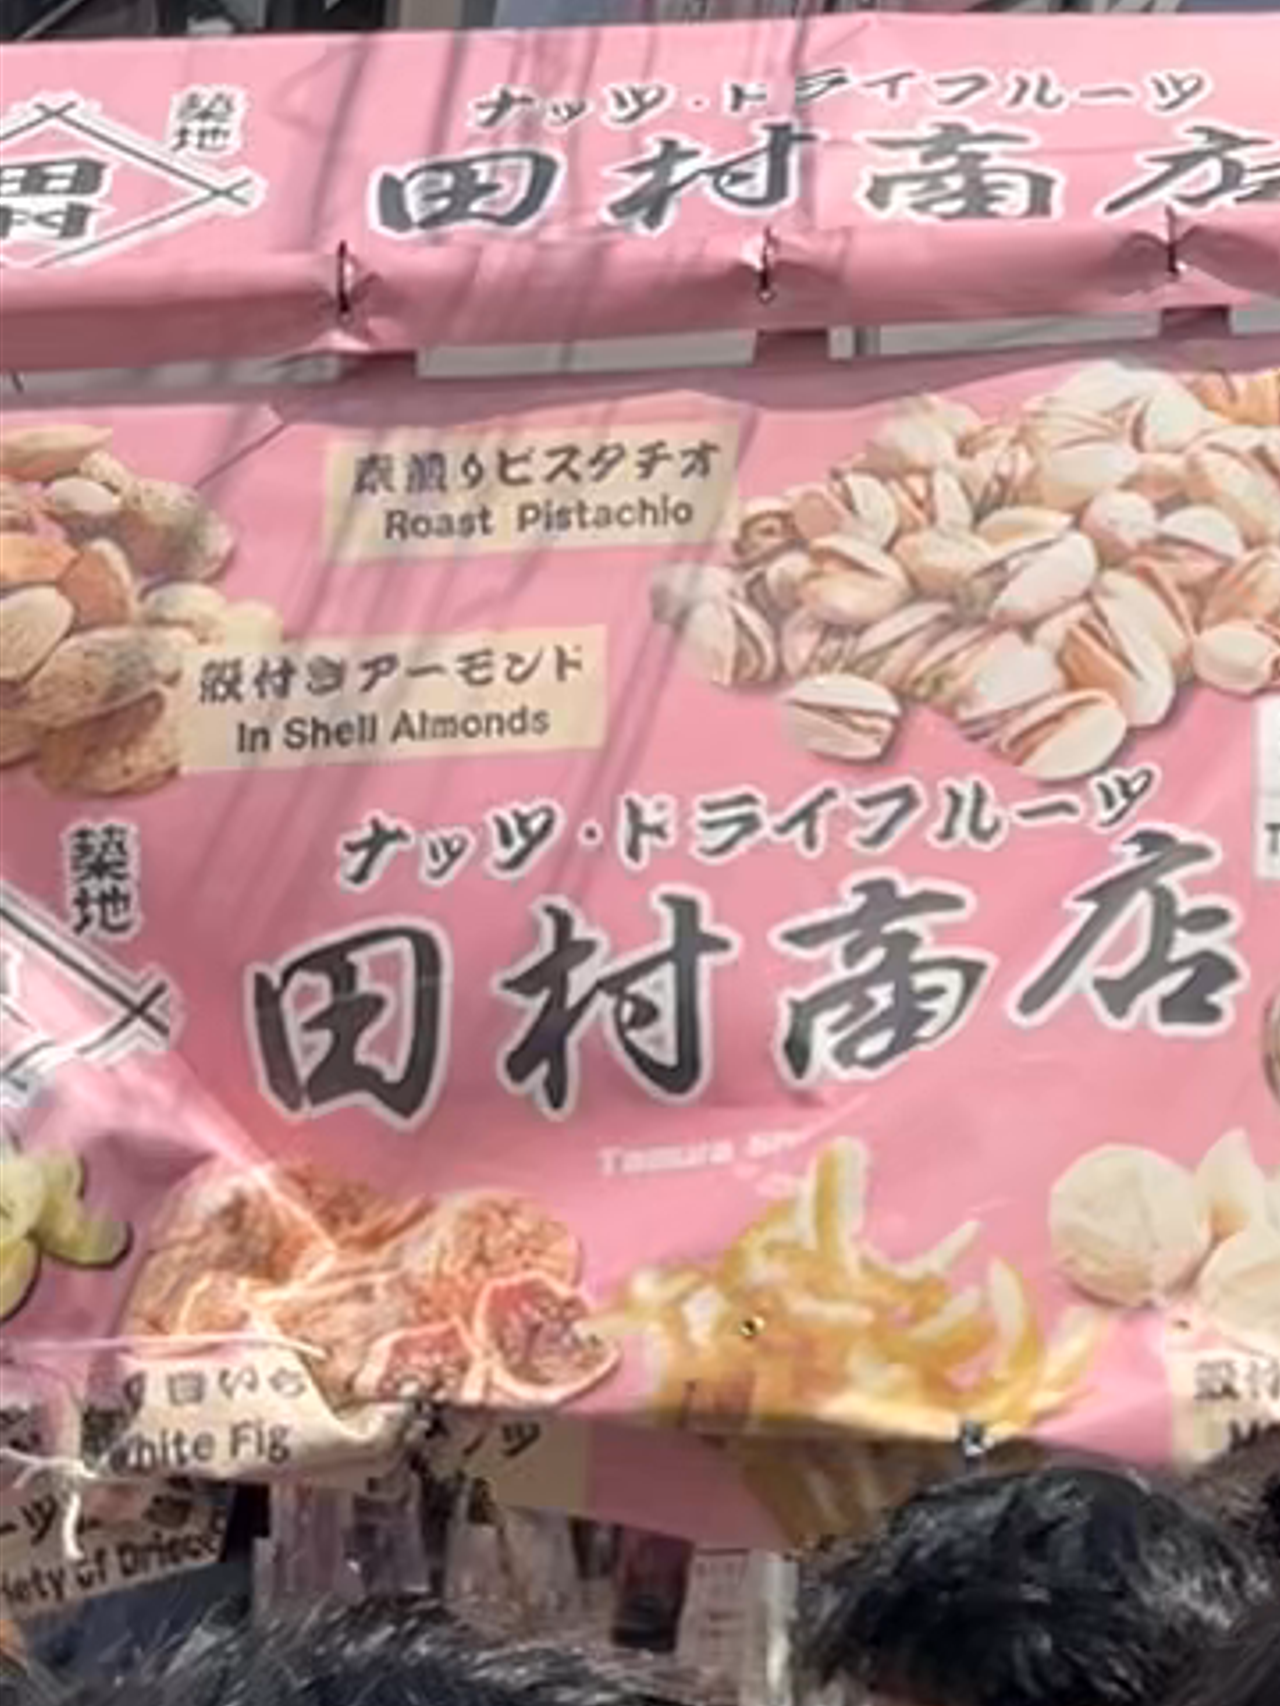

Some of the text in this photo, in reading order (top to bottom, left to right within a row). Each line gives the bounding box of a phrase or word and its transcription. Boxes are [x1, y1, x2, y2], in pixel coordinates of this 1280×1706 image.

[172, 92, 235, 153] 築地
[384, 495, 696, 540] Roast Pistachio
[198, 642, 585, 704] 殻付きアーモンド
[236, 703, 551, 754] In Shell Almonds
[70, 826, 136, 936] 築地
[253, 829, 1240, 1116] 田村商店
[229, 1422, 290, 1460] Fig
